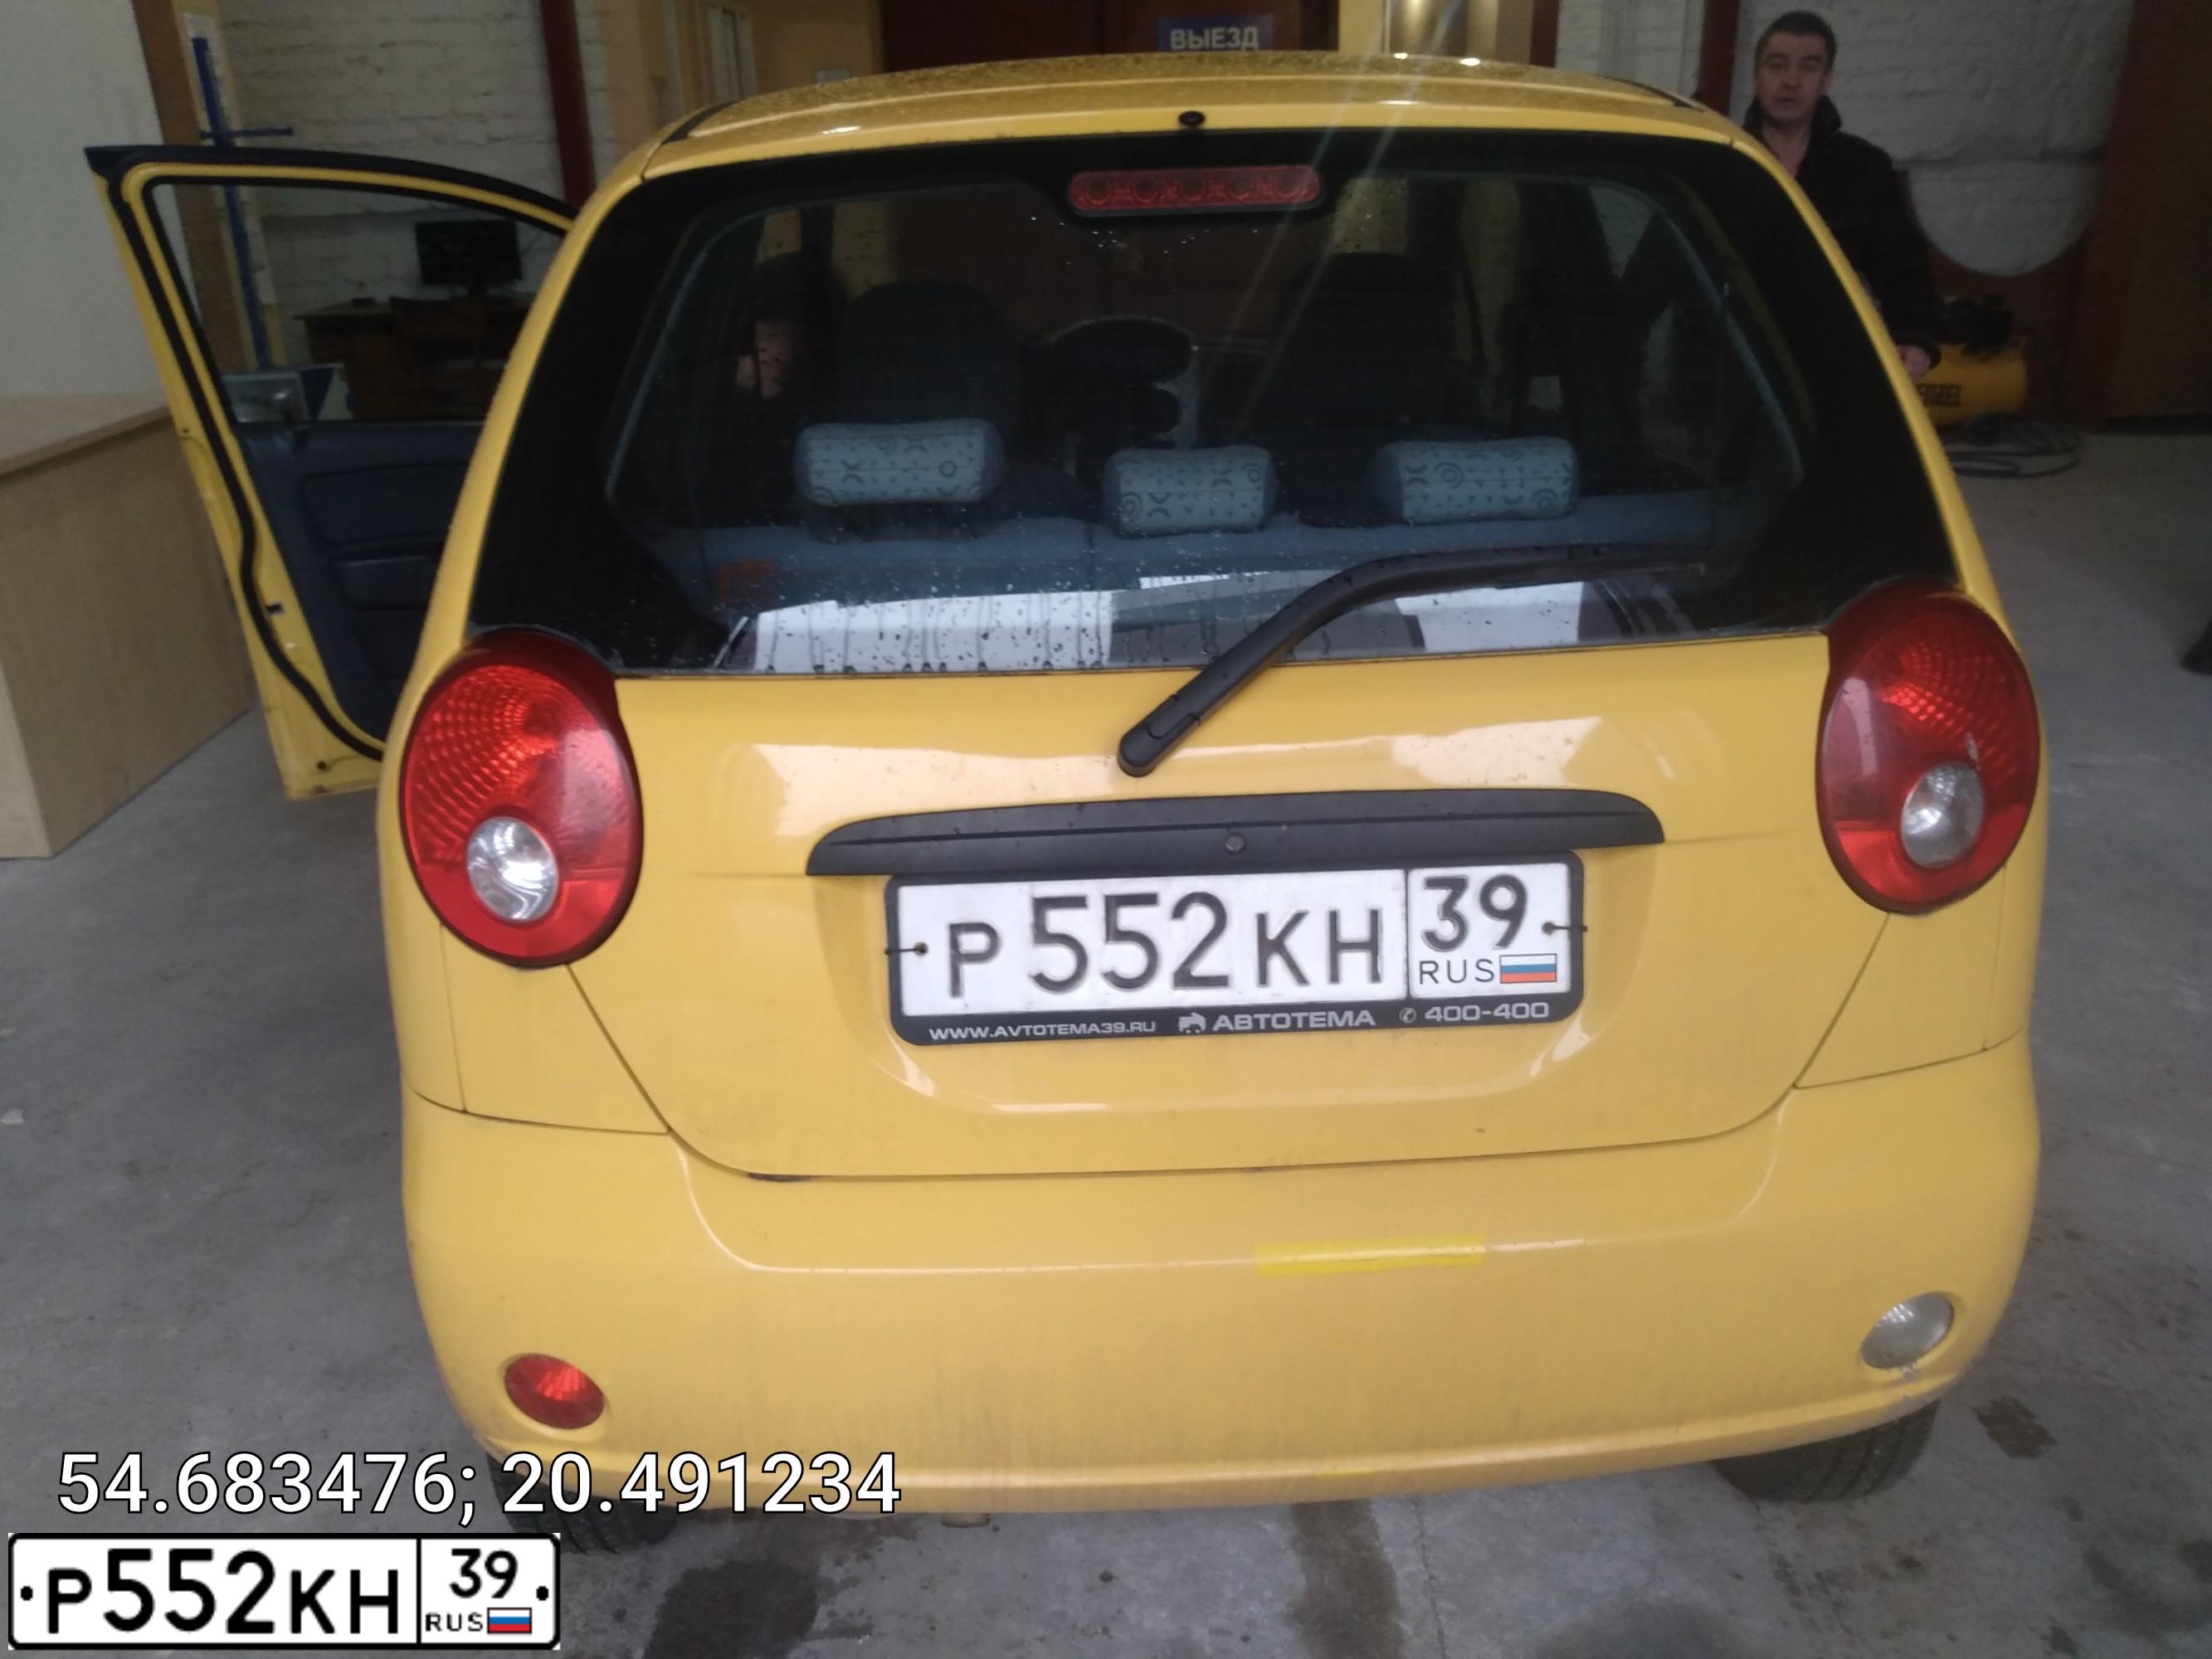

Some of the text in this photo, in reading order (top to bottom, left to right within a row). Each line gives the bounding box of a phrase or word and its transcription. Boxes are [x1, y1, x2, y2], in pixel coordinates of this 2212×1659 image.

[1169, 26, 1259, 51] ВЫЕЗД
[1420, 874, 1529, 952] 39
[1418, 956, 1495, 985] RUS
[928, 1020, 1157, 1040] WWW.AVTOTEMA39.RU
[1211, 1001, 1550, 1032] АВТОТЕМА 400-400
